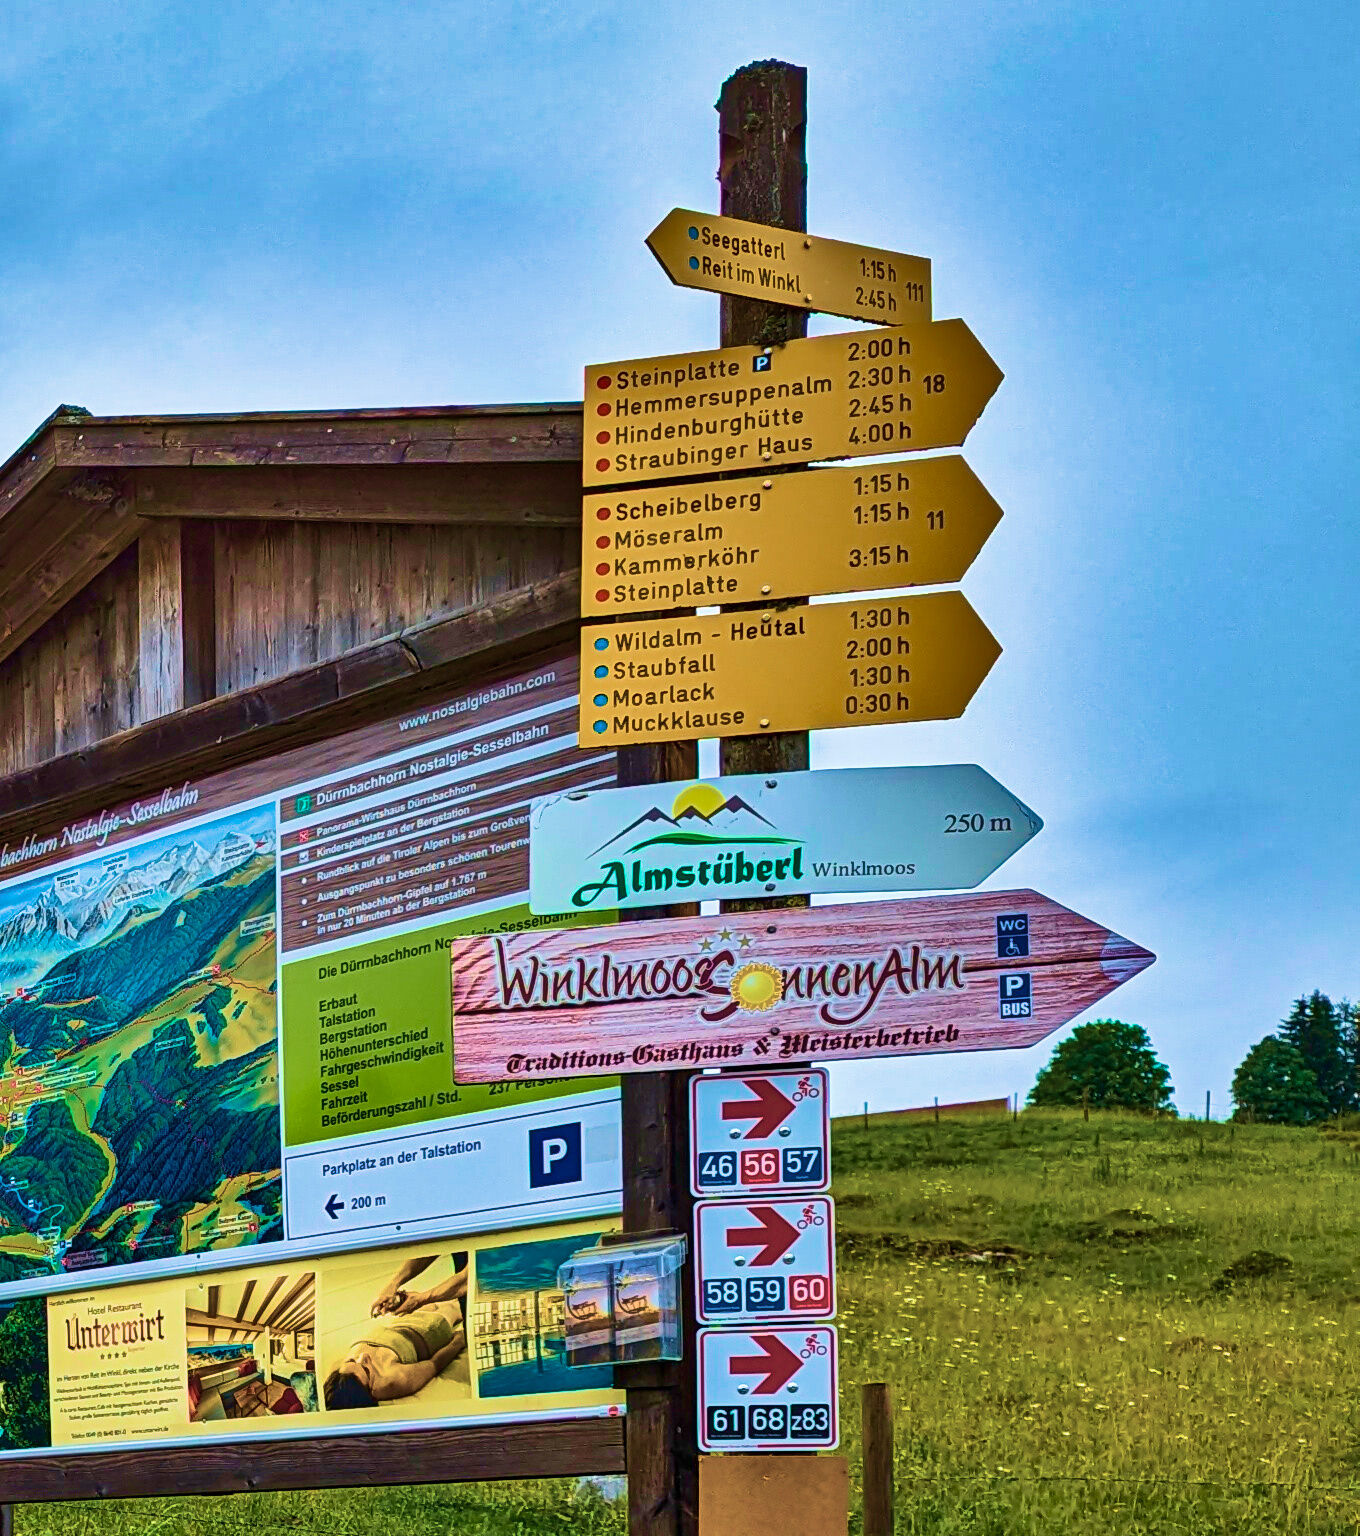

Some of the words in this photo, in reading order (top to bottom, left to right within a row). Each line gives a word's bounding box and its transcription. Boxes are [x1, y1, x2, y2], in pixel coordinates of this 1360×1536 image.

[702, 227, 785, 261] Seegatterl
[860, 257, 885, 281] 1:15
[888, 263, 896, 282] h
[702, 256, 733, 280] Reit
[737, 265, 755, 284] im
[758, 268, 801, 293] Winkl
[855, 287, 885, 310] 2:45
[888, 292, 896, 312] h
[905, 281, 924, 302] 111
[616, 360, 740, 390] Steinplatte
[848, 338, 892, 361] 2:00
[898, 337, 910, 355] h
[922, 374, 945, 394] 18
[615, 376, 832, 417] Hemmersuppenalm
[848, 366, 893, 389] 2:30
[899, 365, 911, 383] h
[615, 409, 803, 445] Hindenburghütte
[849, 394, 894, 418] 2:45
[899, 393, 911, 411] h
[615, 444, 748, 472] Straubinger
[758, 436, 813, 457] Haus
[848, 422, 894, 445] 4:00
[899, 421, 911, 440] h
[616, 493, 761, 521] Scheibelberg
[853, 473, 891, 495] 1:15
[897, 472, 909, 491] h
[615, 523, 723, 550] Möseralm
[853, 503, 891, 524] 1:15
[897, 501, 909, 520] h
[926, 509, 944, 530] 11
[614, 547, 759, 576] Kammerköhr
[614, 575, 738, 602] Steinplatte
[849, 546, 891, 568] 3:15
[896, 545, 908, 563] h
[615, 628, 702, 652] Wildalm
[850, 608, 891, 629] 1:30
[897, 607, 910, 625] h
[613, 654, 716, 680] Staubfall
[846, 637, 891, 659] 2:00
[897, 636, 910, 654] h
[398, 671, 556, 732] www.nostalgiebahn.com
[613, 683, 715, 708] Moarlack
[849, 665, 891, 687] 1:30
[897, 664, 910, 683] h
[613, 710, 745, 733] Muckklause
[845, 693, 891, 714] 0:30
[897, 692, 909, 710] h
[316, 768, 407, 806] Dürrnbachhorn
[409, 722, 550, 777] Nostalgie-Sesselbahn
[60, 781, 199, 847] Nostalgie-Sesselbahn
[316, 804, 406, 837] Panorama-Wirtshaus
[407, 783, 477, 810] Dürrnbachhorn
[943, 813, 984, 833] 250
[989, 815, 1012, 832] m
[316, 831, 386, 859] Kinderspielplatz
[399, 821, 416, 834] der
[416, 806, 470, 829] Bergstation
[316, 862, 360, 882] Rundblick
[361, 857, 376, 869] auf
[377, 853, 391, 865] die
[392, 845, 422, 861] Tiroler
[422, 837, 450, 853] Alpen
[451, 832, 467, 844] bis
[467, 827, 488, 840] zum
[812, 860, 916, 878] Winklmoos
[316, 876, 385, 903] Ausgangspunkt
[385, 873, 397, 885] zu
[398, 860, 446, 881] besonders
[447, 850, 488, 868] schönen
[571, 846, 805, 906] Almstüberl
[316, 911, 337, 924] Zum
[337, 886, 433, 918] Dürrnbachhorn-Gipfel
[433, 879, 450, 892] auf
[451, 873, 477, 887] 1.767
[327, 921, 342, 934] nur
[343, 917, 355, 929] 20
[355, 907, 391, 925] Minuten
[392, 904, 404, 916] ab
[405, 900, 421, 913] der
[422, 885, 476, 907] Bergstation
[999, 919, 1026, 932] WC
[318, 966, 338, 980] Die
[340, 942, 432, 975] Dürrnbachhorn
[318, 993, 358, 1013] Erbaut
[319, 1006, 376, 1029] Talstation
[1002, 1001, 1030, 1016] BUS
[319, 1021, 387, 1046] Bergstation
[320, 1027, 429, 1062] Höhenunterschied
[506, 1041, 744, 1073] Traditions-Gasthaus
[779, 1024, 960, 1058] Meisterbetrieb
[320, 1042, 444, 1078] Fahrgeschwindigkeit
[320, 1076, 359, 1094] Sessel
[321, 1091, 368, 1111] Fahrzeit
[321, 1095, 427, 1128] Beförderungszahl
[436, 1090, 462, 1105] Std.
[322, 1157, 376, 1177] Parkplatz
[379, 1155, 394, 1168] an
[397, 1148, 418, 1163] der
[420, 1139, 481, 1160] Talstation
[701, 1155, 733, 1177] 46
[744, 1153, 776, 1177] 56
[786, 1149, 819, 1173] 57
[351, 1195, 372, 1210] 200
[374, 1194, 387, 1206] m
[87, 1305, 106, 1316] Hotel
[107, 1302, 143, 1314] Restaurant
[707, 1281, 739, 1304] 58
[749, 1279, 780, 1303] 59
[793, 1278, 825, 1301] 60
[65, 1309, 165, 1351] Unterwirt
[713, 1409, 739, 1431] 61
[752, 1408, 784, 1431] 68
[791, 1407, 829, 1431] z83
